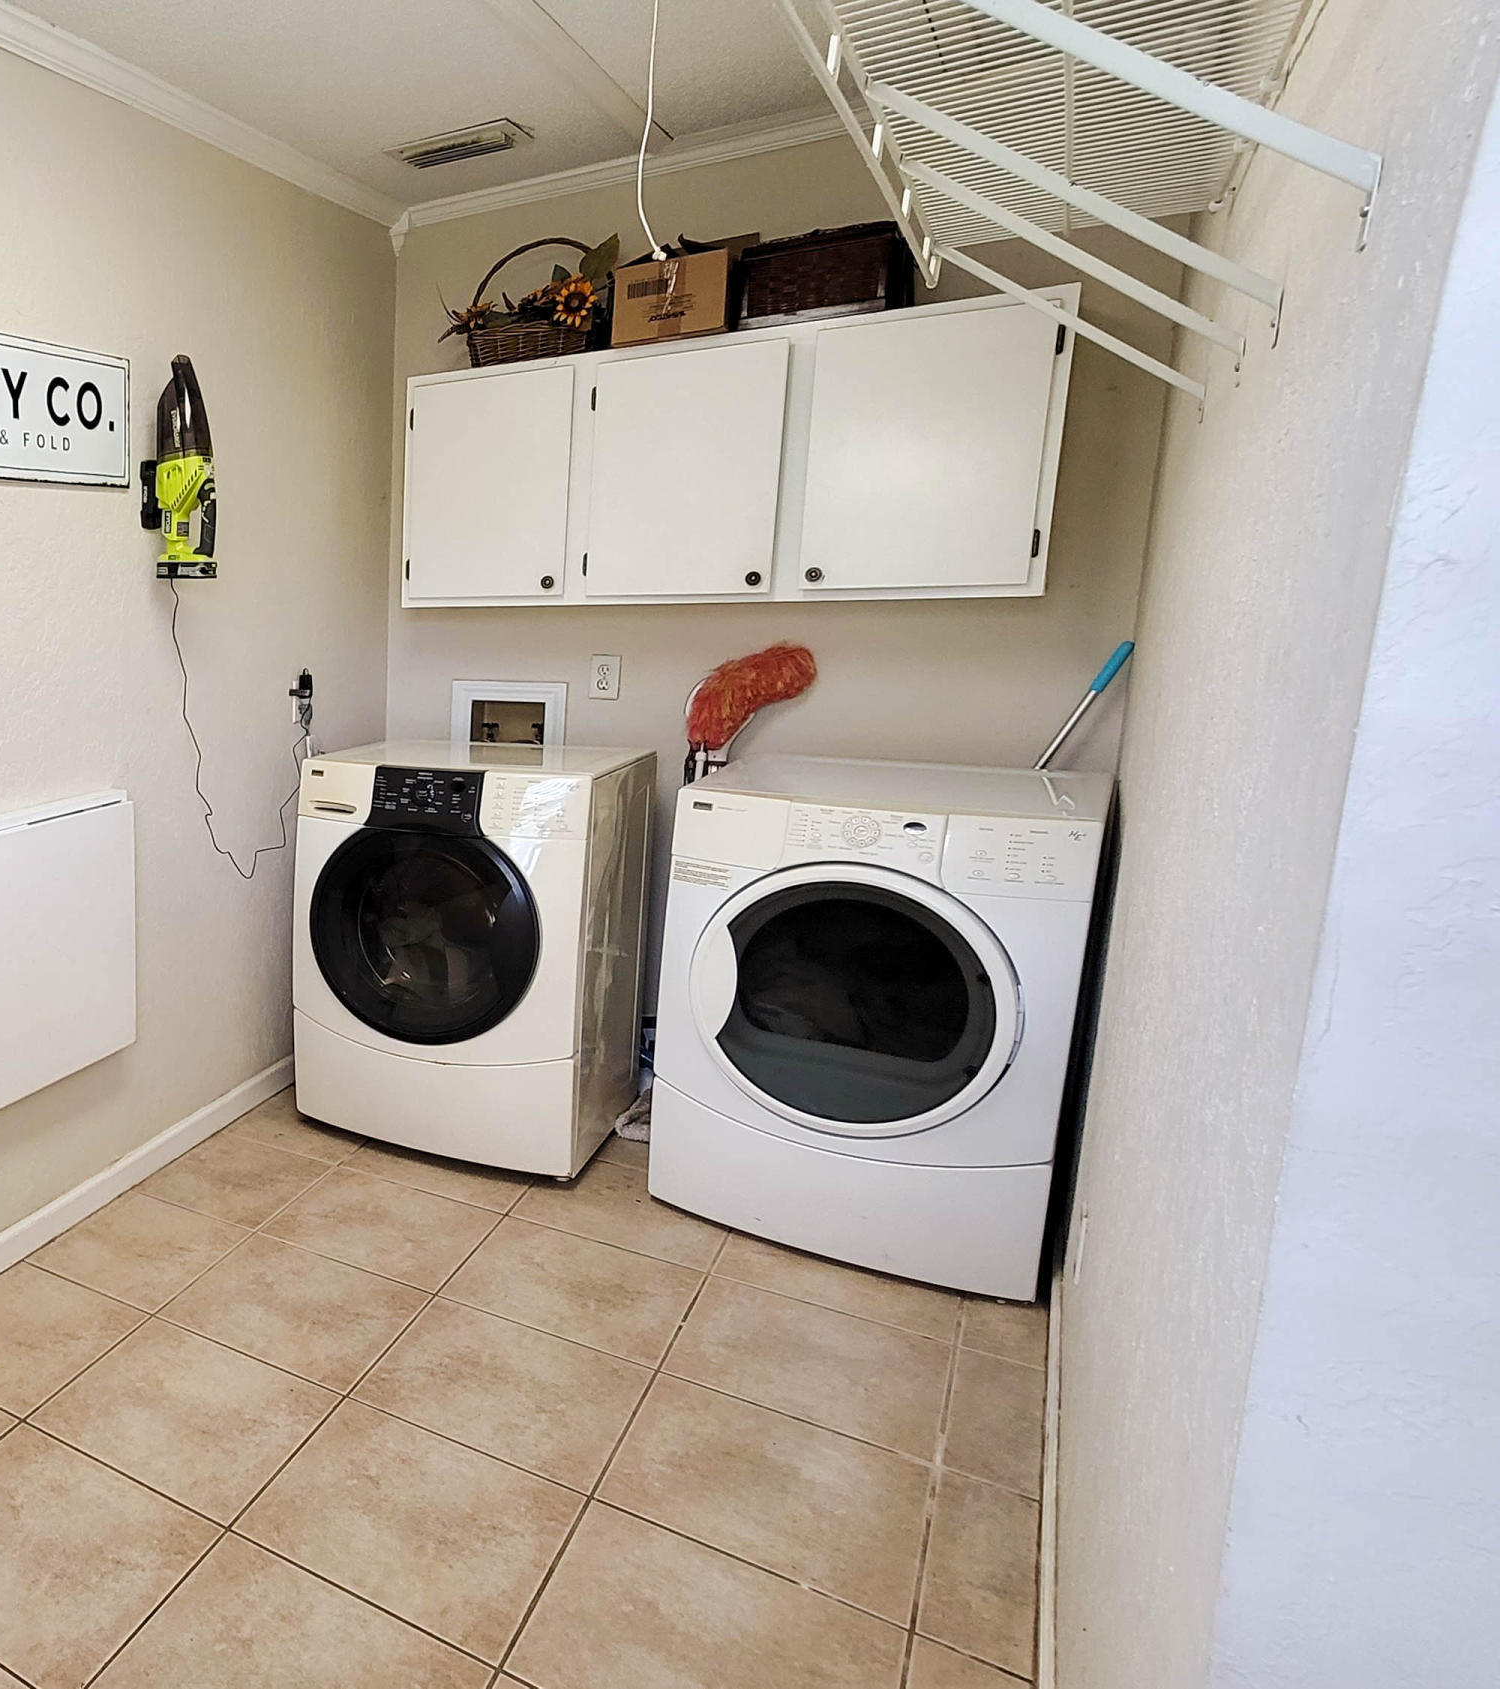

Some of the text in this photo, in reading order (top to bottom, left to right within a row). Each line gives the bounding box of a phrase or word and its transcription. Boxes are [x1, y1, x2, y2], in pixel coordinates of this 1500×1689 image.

[46, 376, 116, 432] CO.
[0, 429, 9, 445] &
[23, 432, 71, 452] FOLD
